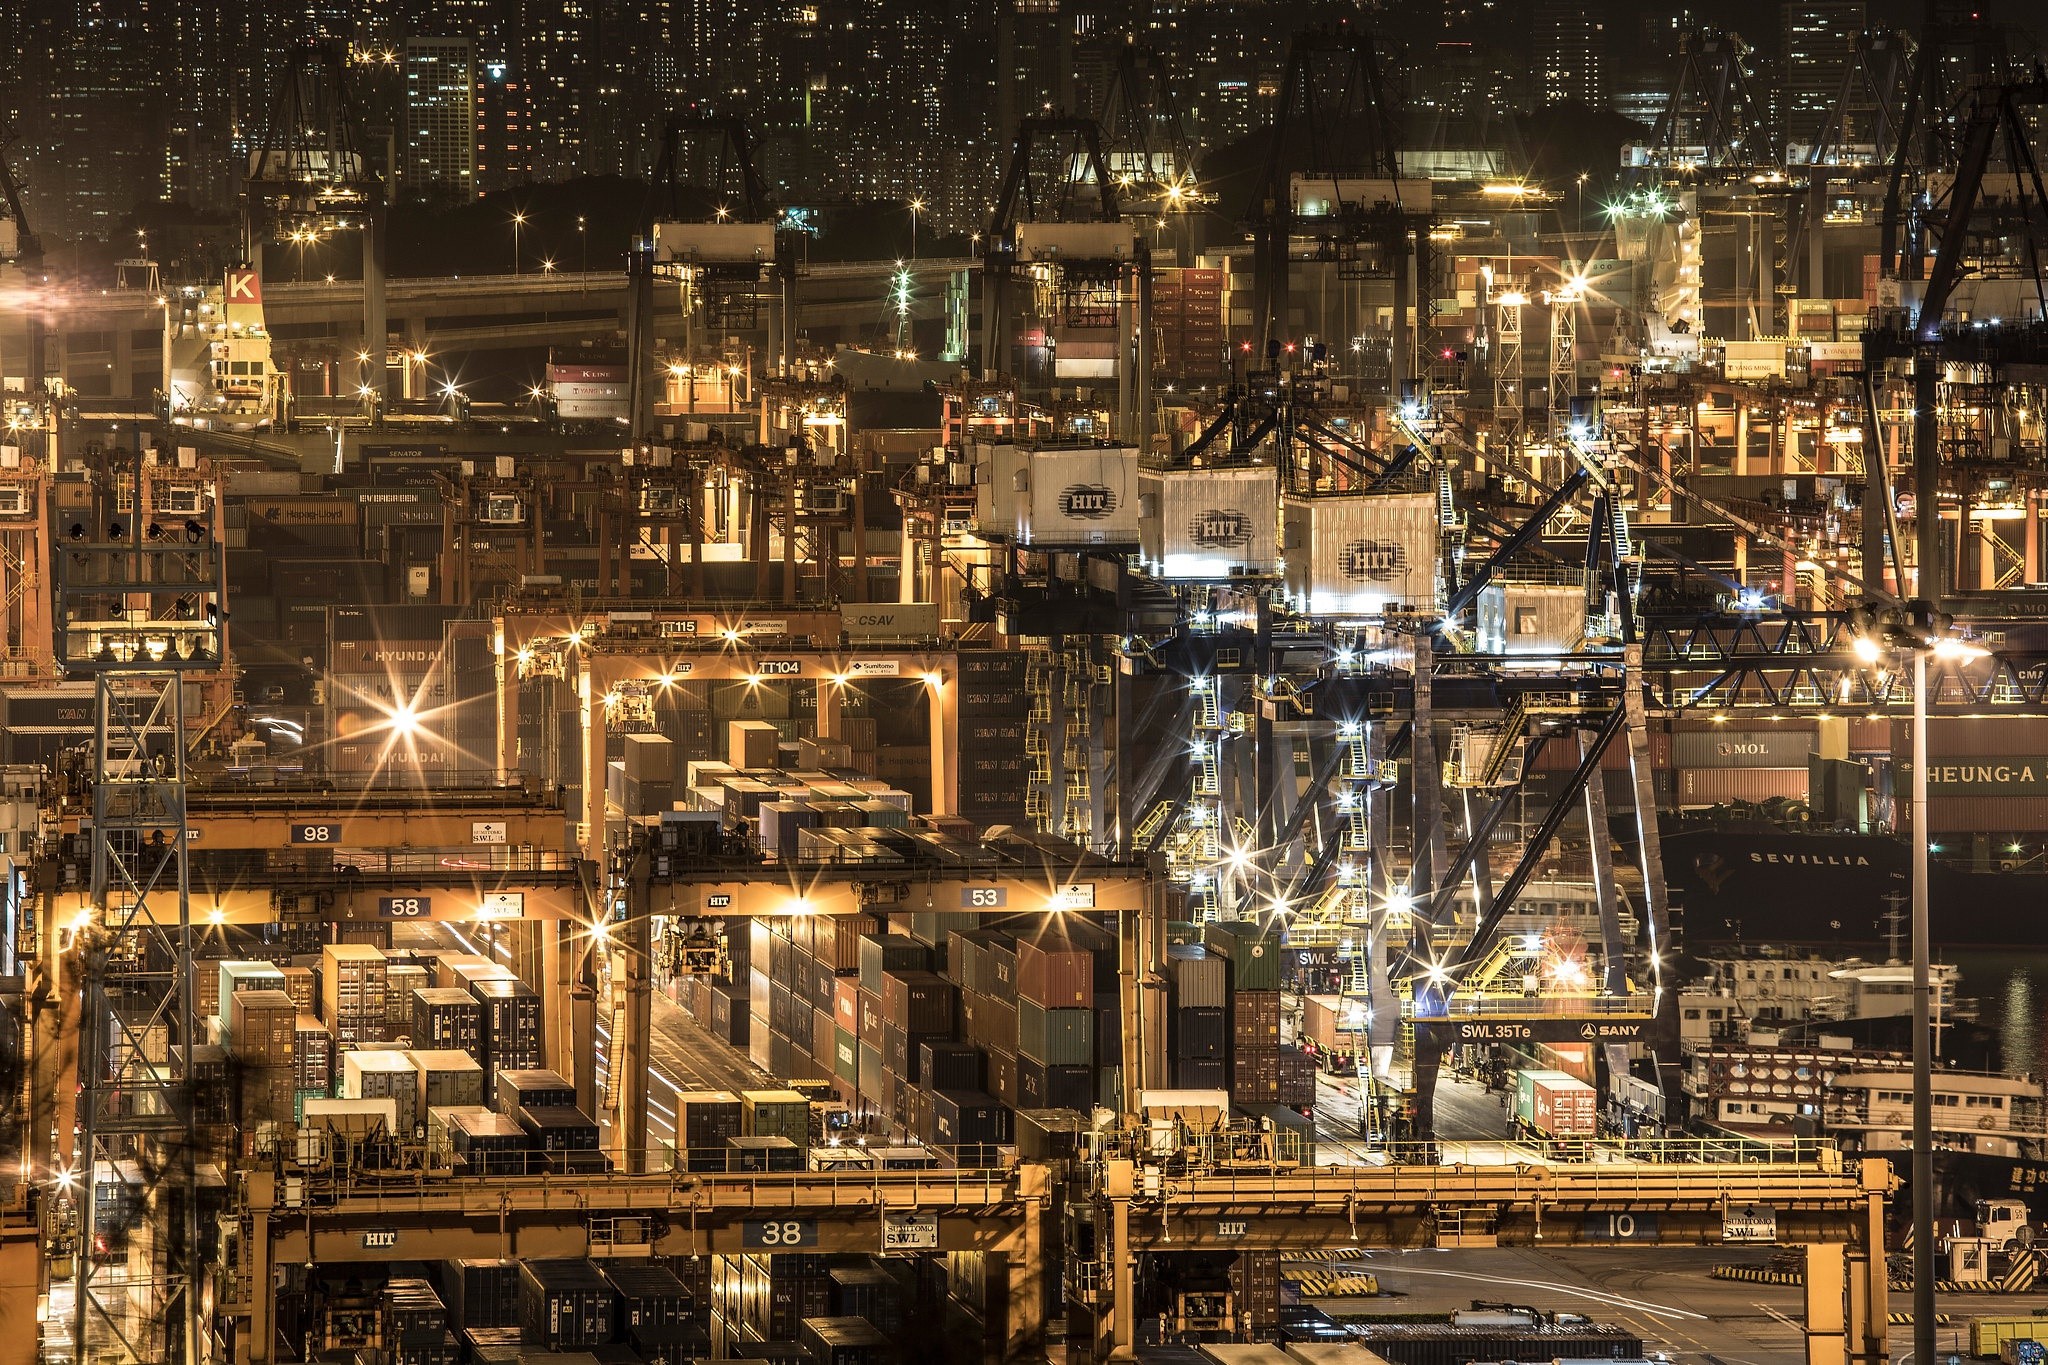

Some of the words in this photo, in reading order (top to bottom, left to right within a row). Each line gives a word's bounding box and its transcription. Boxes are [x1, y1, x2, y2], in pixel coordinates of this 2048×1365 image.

[231, 275, 254, 298] K
[582, 370, 590, 378] K
[359, 494, 418, 503] EVERGREEN
[1071, 494, 1105, 509] HIT
[286, 510, 343, 520] Hapag-Lloyd
[1202, 521, 1239, 536] HIT
[1353, 551, 1392, 568] HIT
[858, 615, 894, 626] CSAV
[659, 621, 696, 632] TT115
[375, 651, 442, 662] HYUNDAI
[758, 661, 799, 673] TT104
[966, 662, 989, 672] WAN
[992, 662, 1012, 672] HAI
[2018, 670, 2045, 680] CMA
[966, 694, 990, 703] WAN
[993, 694, 1013, 703] HAI
[57, 708, 86, 720] WAN
[974, 728, 997, 738] WAN
[1000, 728, 1020, 738] HAI
[1733, 743, 1769, 754] MOL
[1926, 765, 2036, 783] HEUNG-A
[303, 826, 330, 841] 98
[1750, 852, 1869, 866] SEVILLIA
[710, 897, 729, 906] HIT
[972, 889, 998, 906] 53
[391, 899, 419, 915] 58
[1299, 952, 1329, 965] SWL
[912, 991, 926, 999] tex
[341, 1030, 355, 1038] tex
[1461, 1025, 1496, 1038] SWL
[1497, 1025, 1531, 1038] 35Te
[1599, 1025, 1640, 1037] SANY
[1726, 1218, 1773, 1226] SUMITOMO
[761, 1220, 802, 1245] 38
[1219, 1222, 1247, 1235] HIT
[365, 1232, 395, 1246] HIT
[60, 1242, 71, 1250] 98
[776, 1293, 792, 1303] tex
